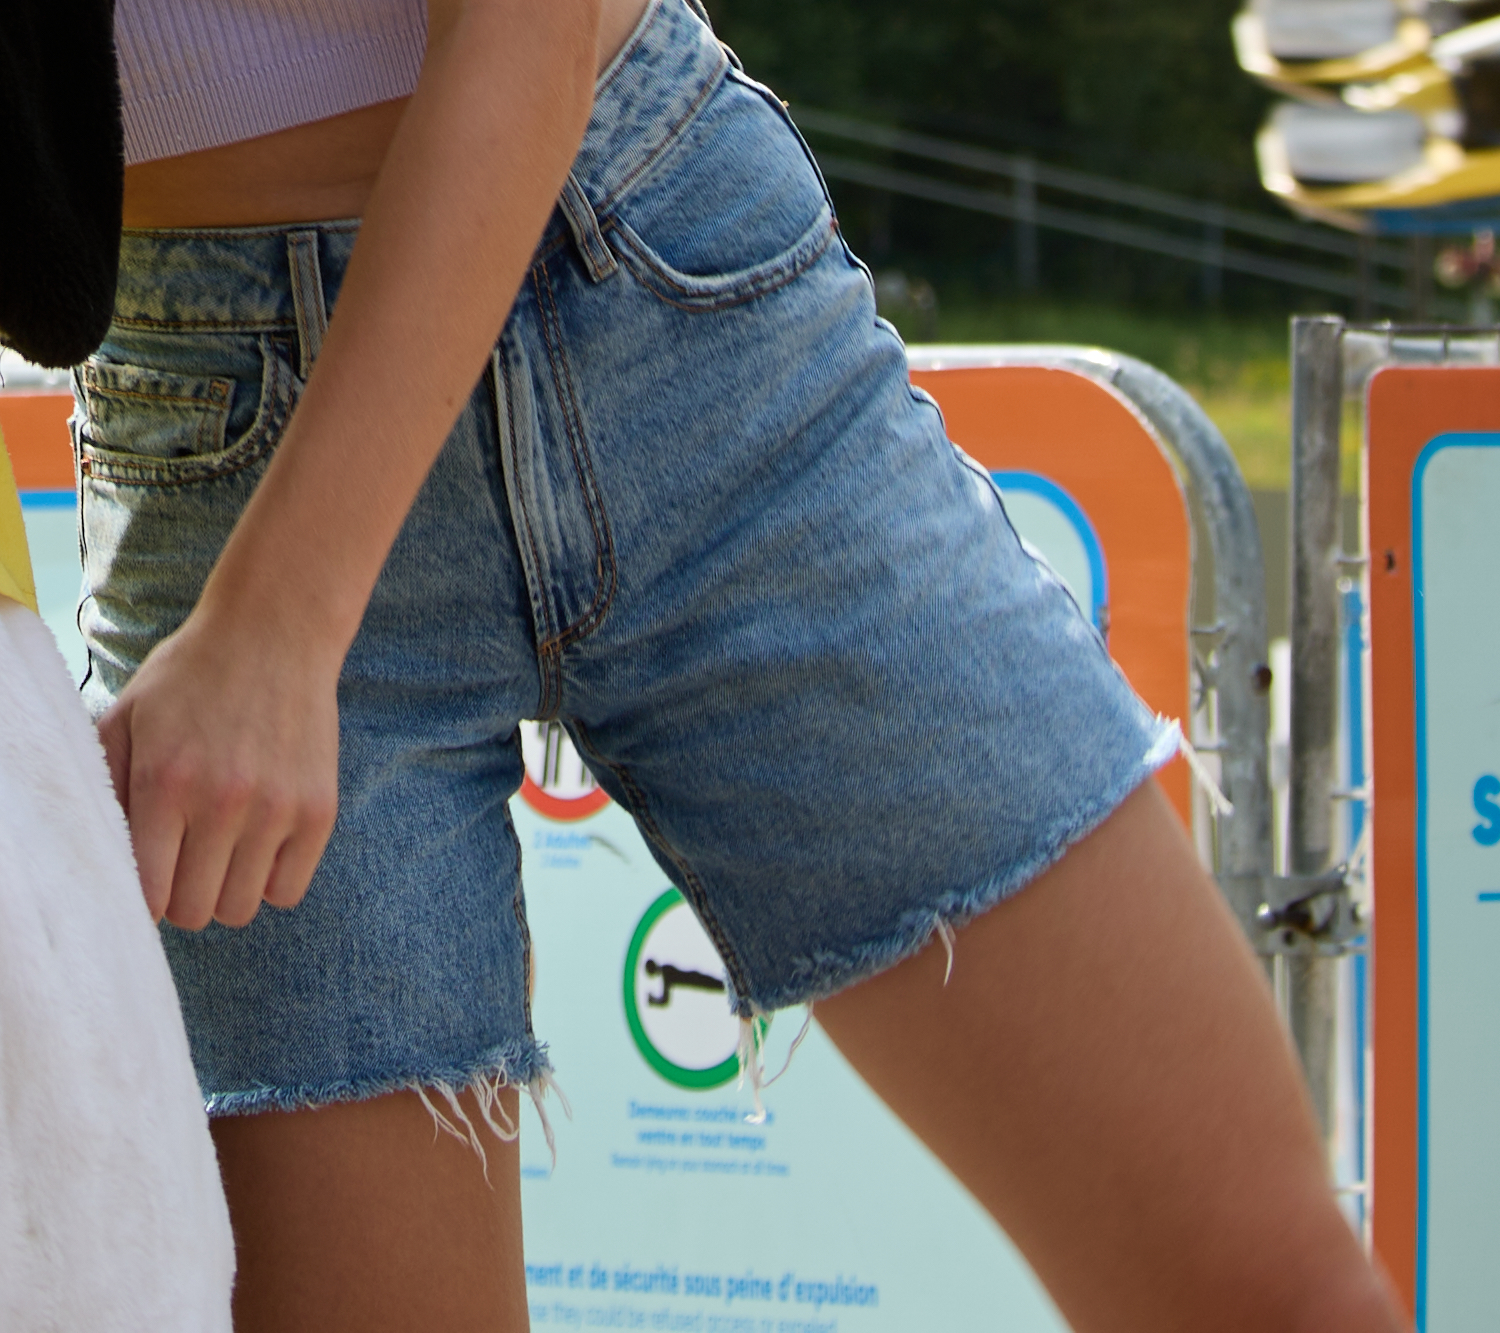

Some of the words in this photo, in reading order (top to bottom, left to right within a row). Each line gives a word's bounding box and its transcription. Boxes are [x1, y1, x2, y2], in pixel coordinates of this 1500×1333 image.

[569, 1264, 584, 1289] et
[589, 1260, 607, 1291] de
[614, 1261, 679, 1295] sécurité
[685, 1275, 721, 1298] sous
[725, 1269, 772, 1308] peine
